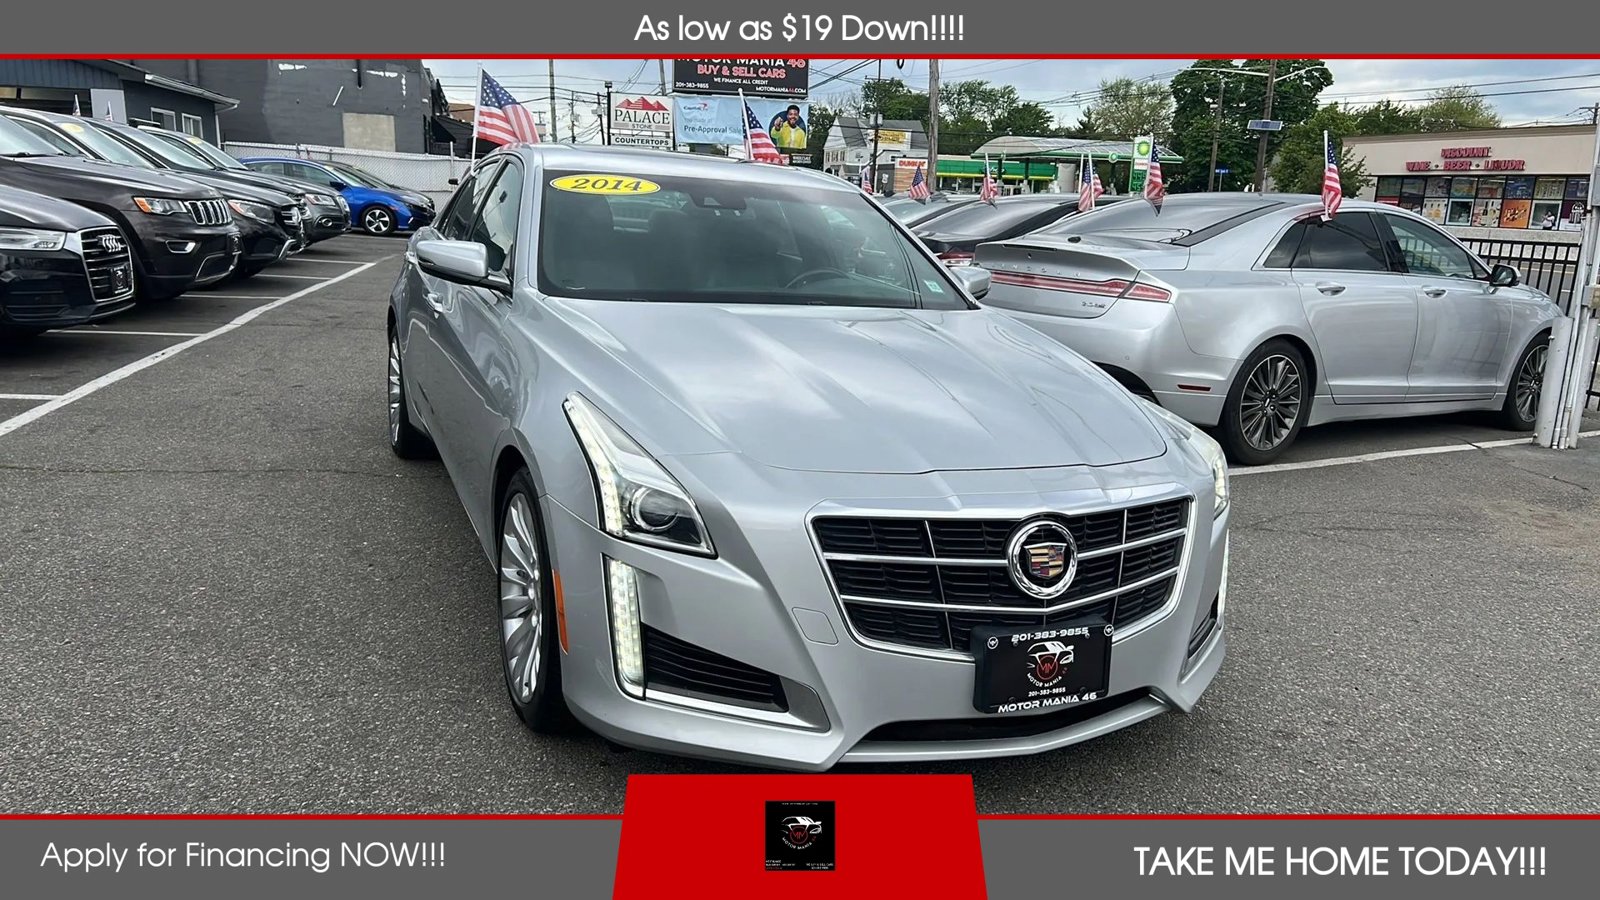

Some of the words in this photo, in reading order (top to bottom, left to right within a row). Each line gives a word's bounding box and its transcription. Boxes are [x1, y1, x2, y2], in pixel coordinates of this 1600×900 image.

[697, 64, 720, 75] BUY
[721, 66, 730, 76] &
[732, 67, 757, 77] SELL
[758, 68, 786, 79] CARS
[614, 109, 670, 125] PALACE
[683, 124, 728, 135] Pre-Approval
[615, 137, 669, 146] COUNTERTOPS
[1441, 147, 1491, 159] DISCOUNT
[1406, 161, 1431, 172] WINE
[1443, 160, 1472, 171] BEER
[1483, 160, 1525, 171] LIQUOR
[571, 178, 642, 192] 2014
[1011, 628, 1088, 642] 201-383-9855
[1027, 672, 1043, 688] MOTOR
[1044, 675, 1062, 688] MANIA
[998, 701, 1040, 713] MOTOR
[1043, 695, 1079, 707] MANIA
[1082, 693, 1097, 701] 46
